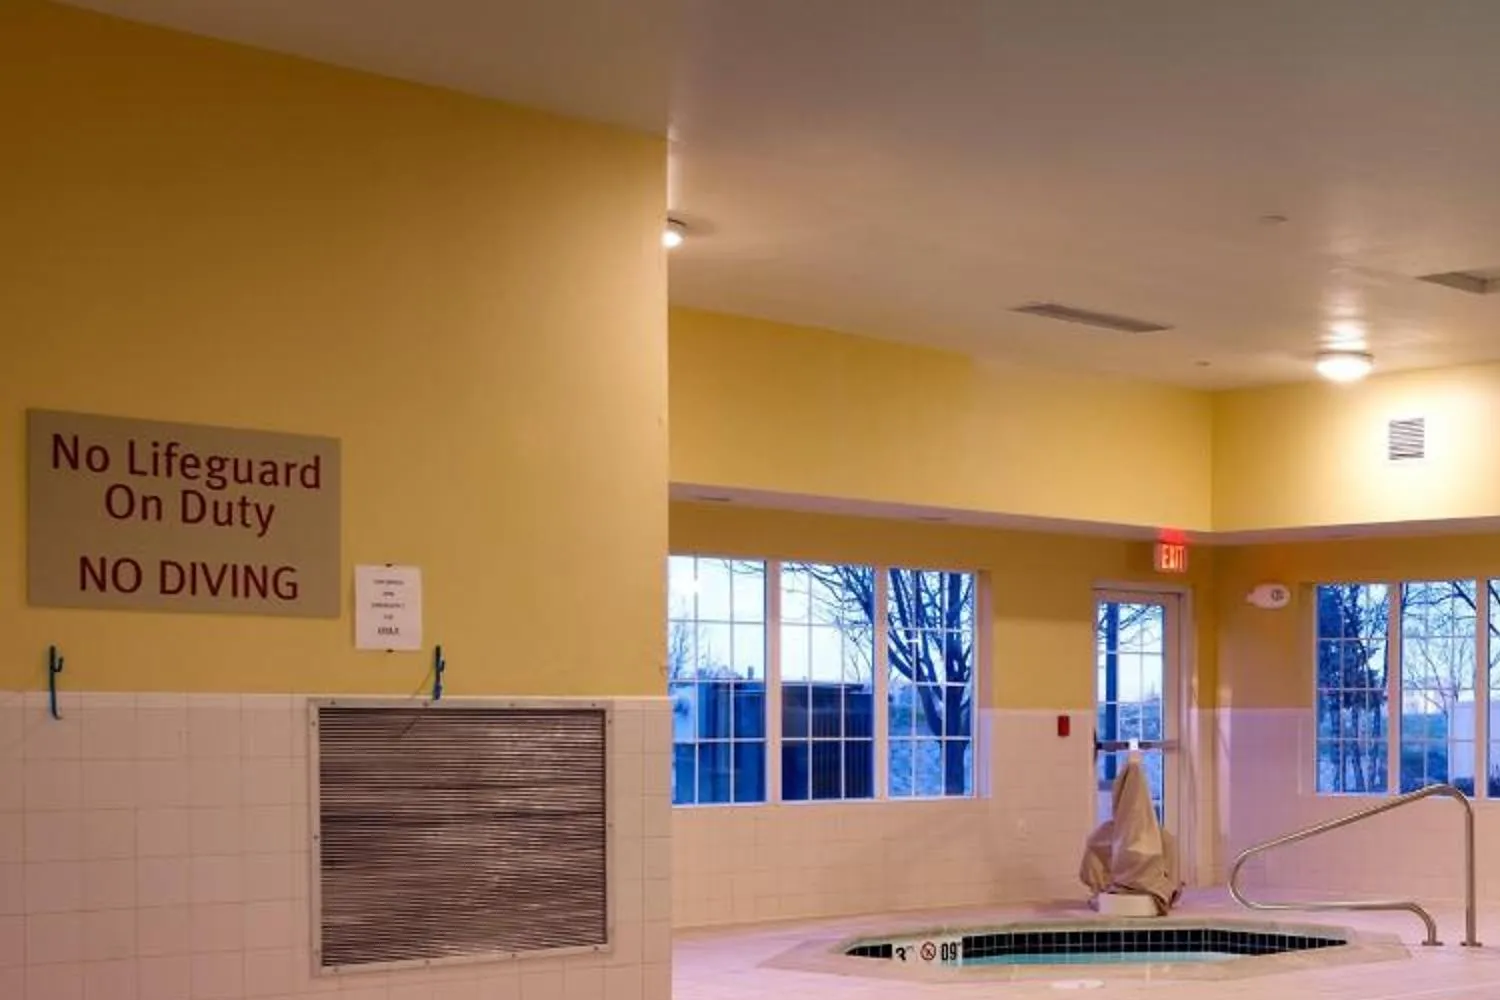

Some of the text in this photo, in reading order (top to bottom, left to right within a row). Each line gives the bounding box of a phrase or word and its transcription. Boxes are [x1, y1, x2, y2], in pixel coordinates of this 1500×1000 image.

[52, 433, 322, 491] No Lifeguard
[105, 484, 275, 537] On Duty
[79, 556, 299, 601] NO DIVING
[1161, 543, 1184, 569] EXIT
